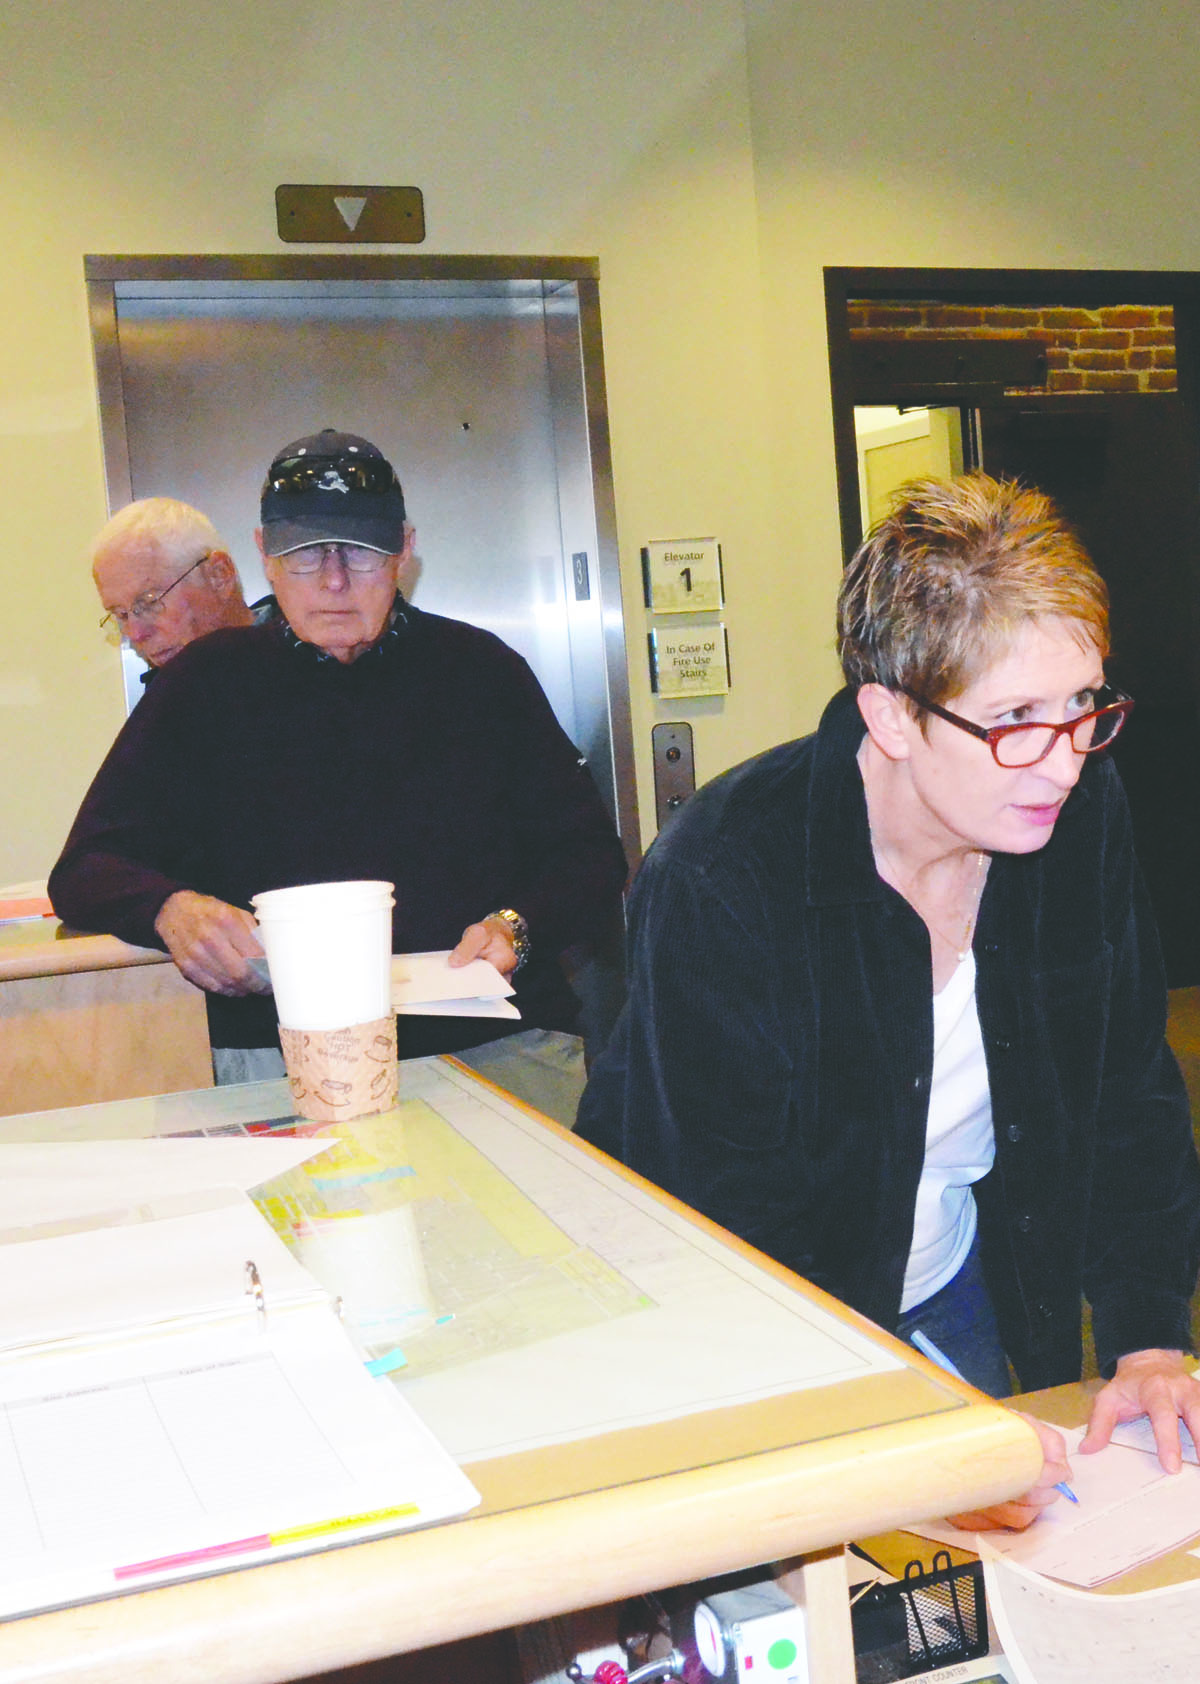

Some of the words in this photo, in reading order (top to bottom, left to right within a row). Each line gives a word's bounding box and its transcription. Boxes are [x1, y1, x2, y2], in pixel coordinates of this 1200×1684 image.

[663, 551, 705, 563] Elevator
[680, 567, 692, 592] 1
[666, 645, 676, 654] In
[678, 643, 701, 654] Case
[703, 642, 715, 652] Of
[673, 656, 691, 666] Fire
[693, 655, 711, 665] Use
[679, 667, 708, 679] Stairs
[931, 1665, 968, 1681] COUNTER
